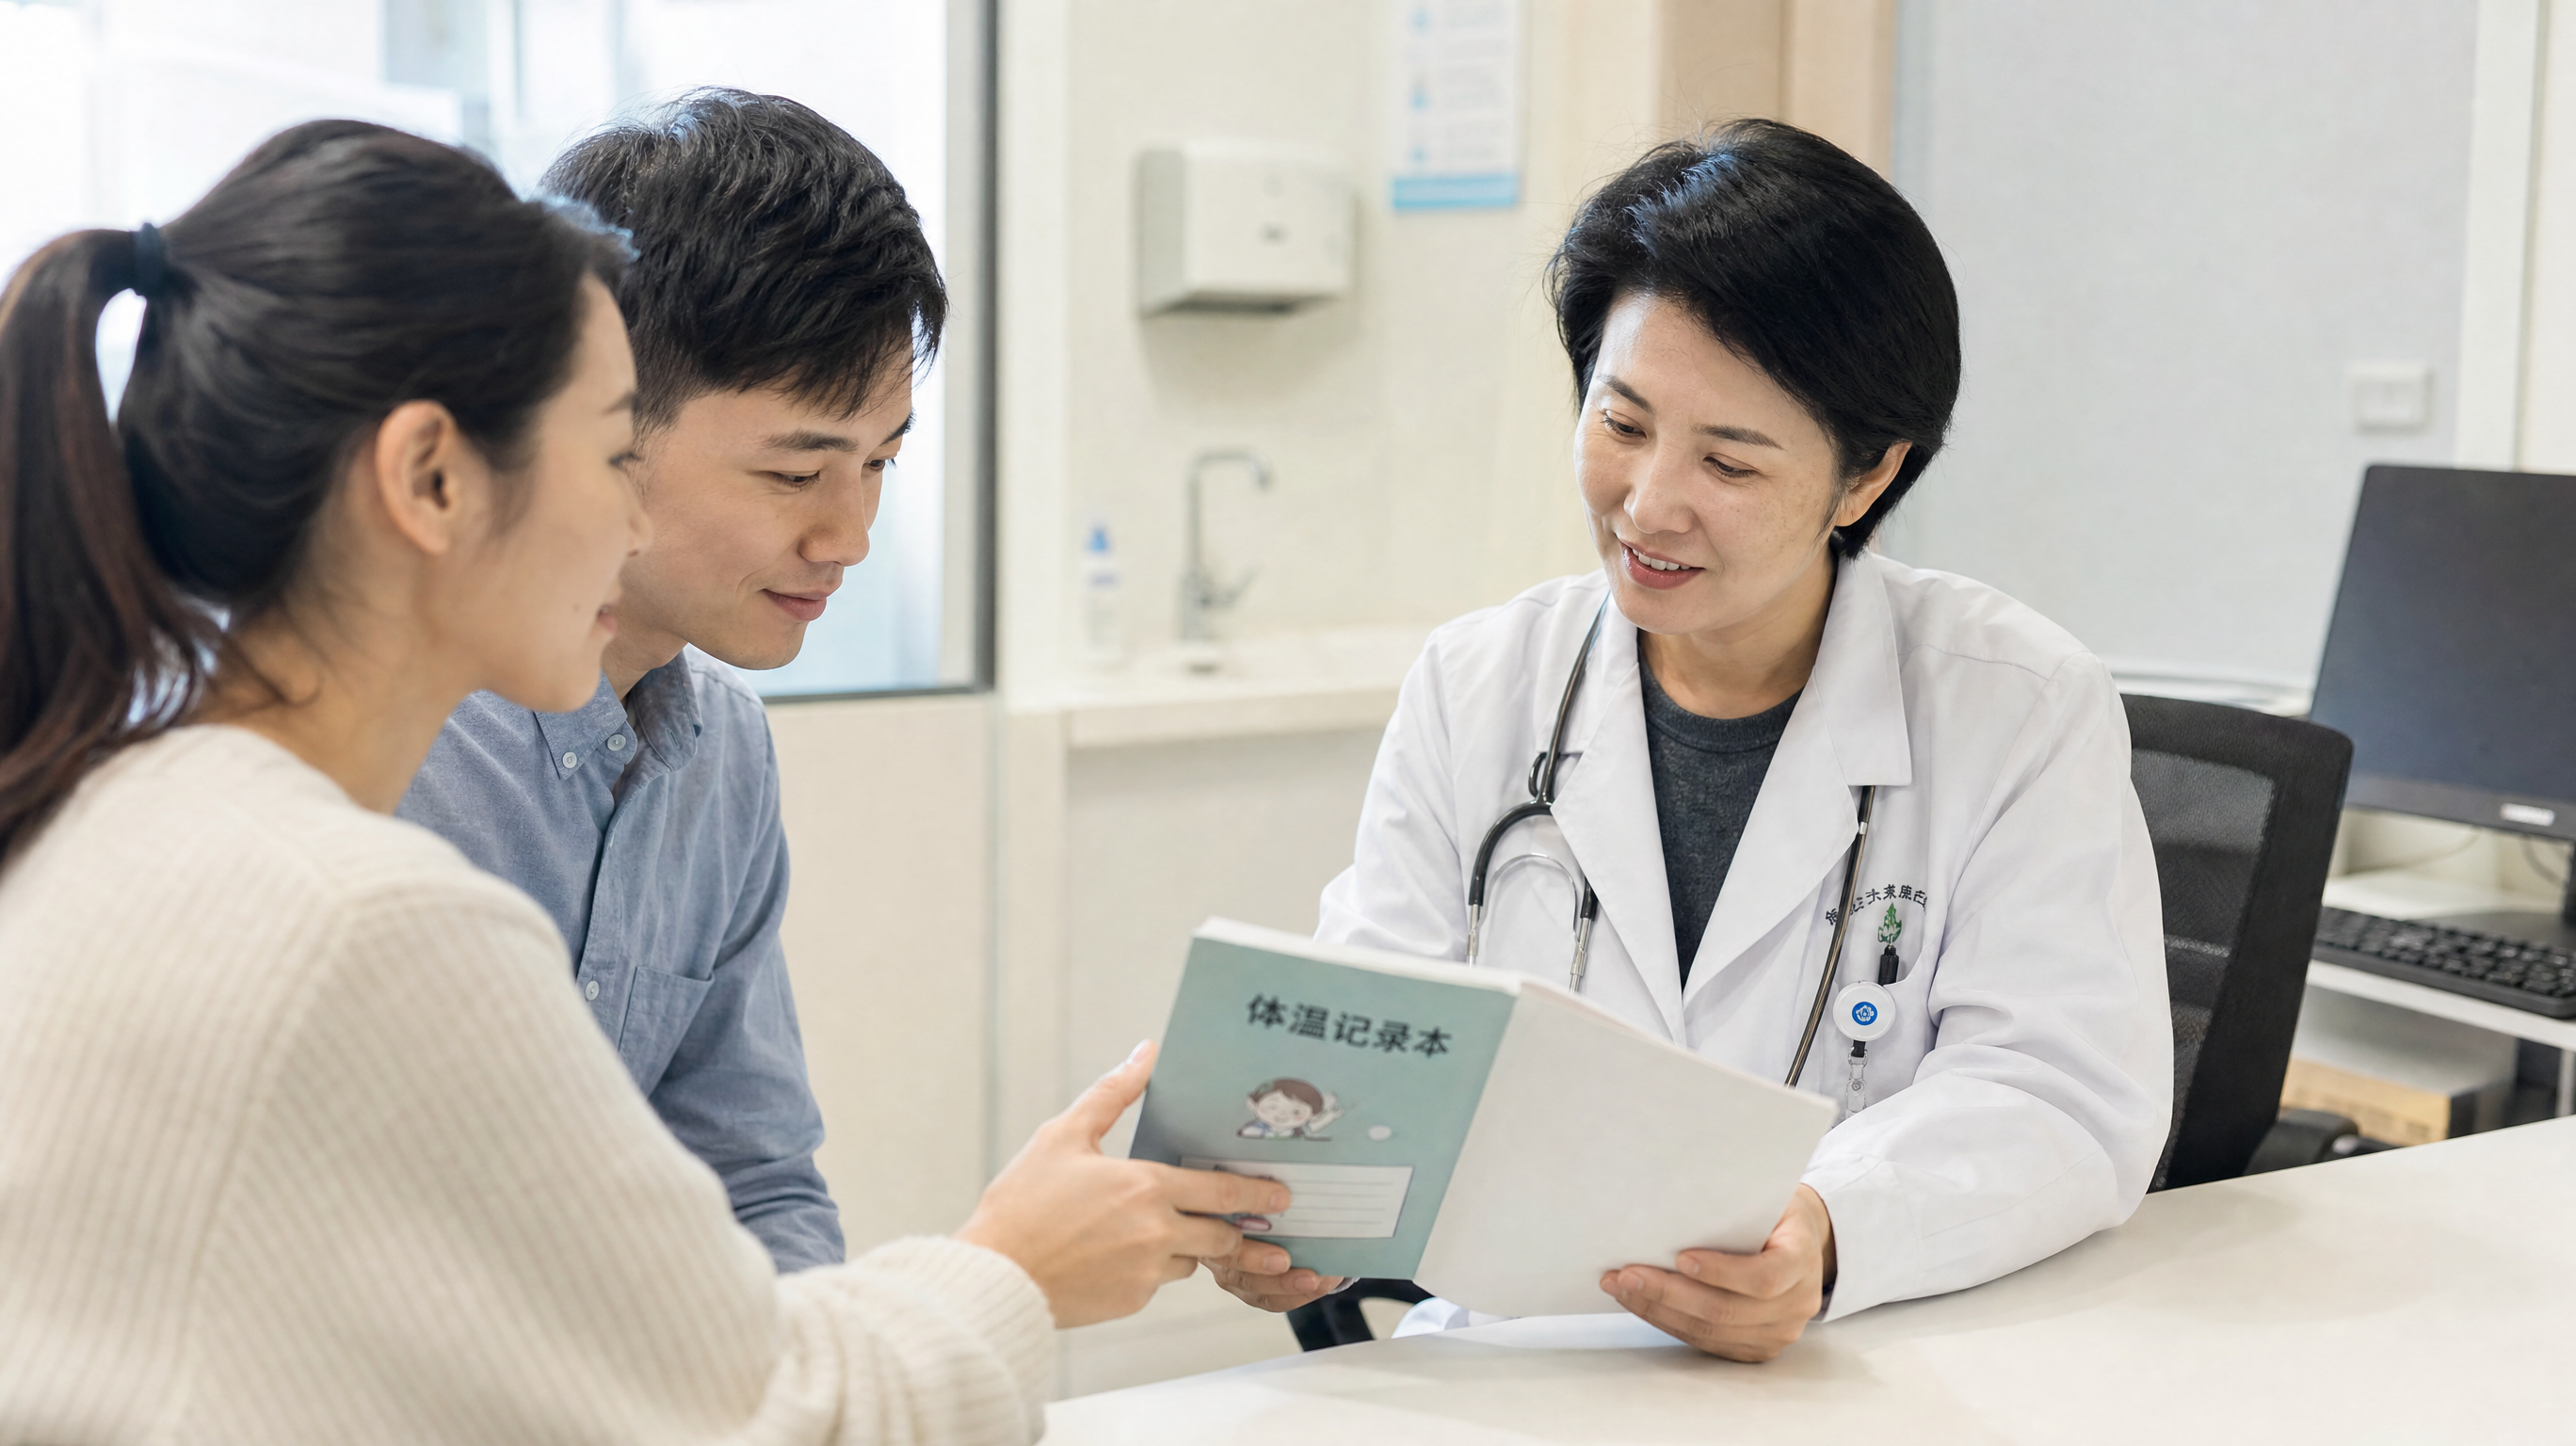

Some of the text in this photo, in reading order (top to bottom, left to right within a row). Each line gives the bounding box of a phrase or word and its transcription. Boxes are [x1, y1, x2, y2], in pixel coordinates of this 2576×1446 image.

[1248, 993, 1452, 1057] 体温记录本
